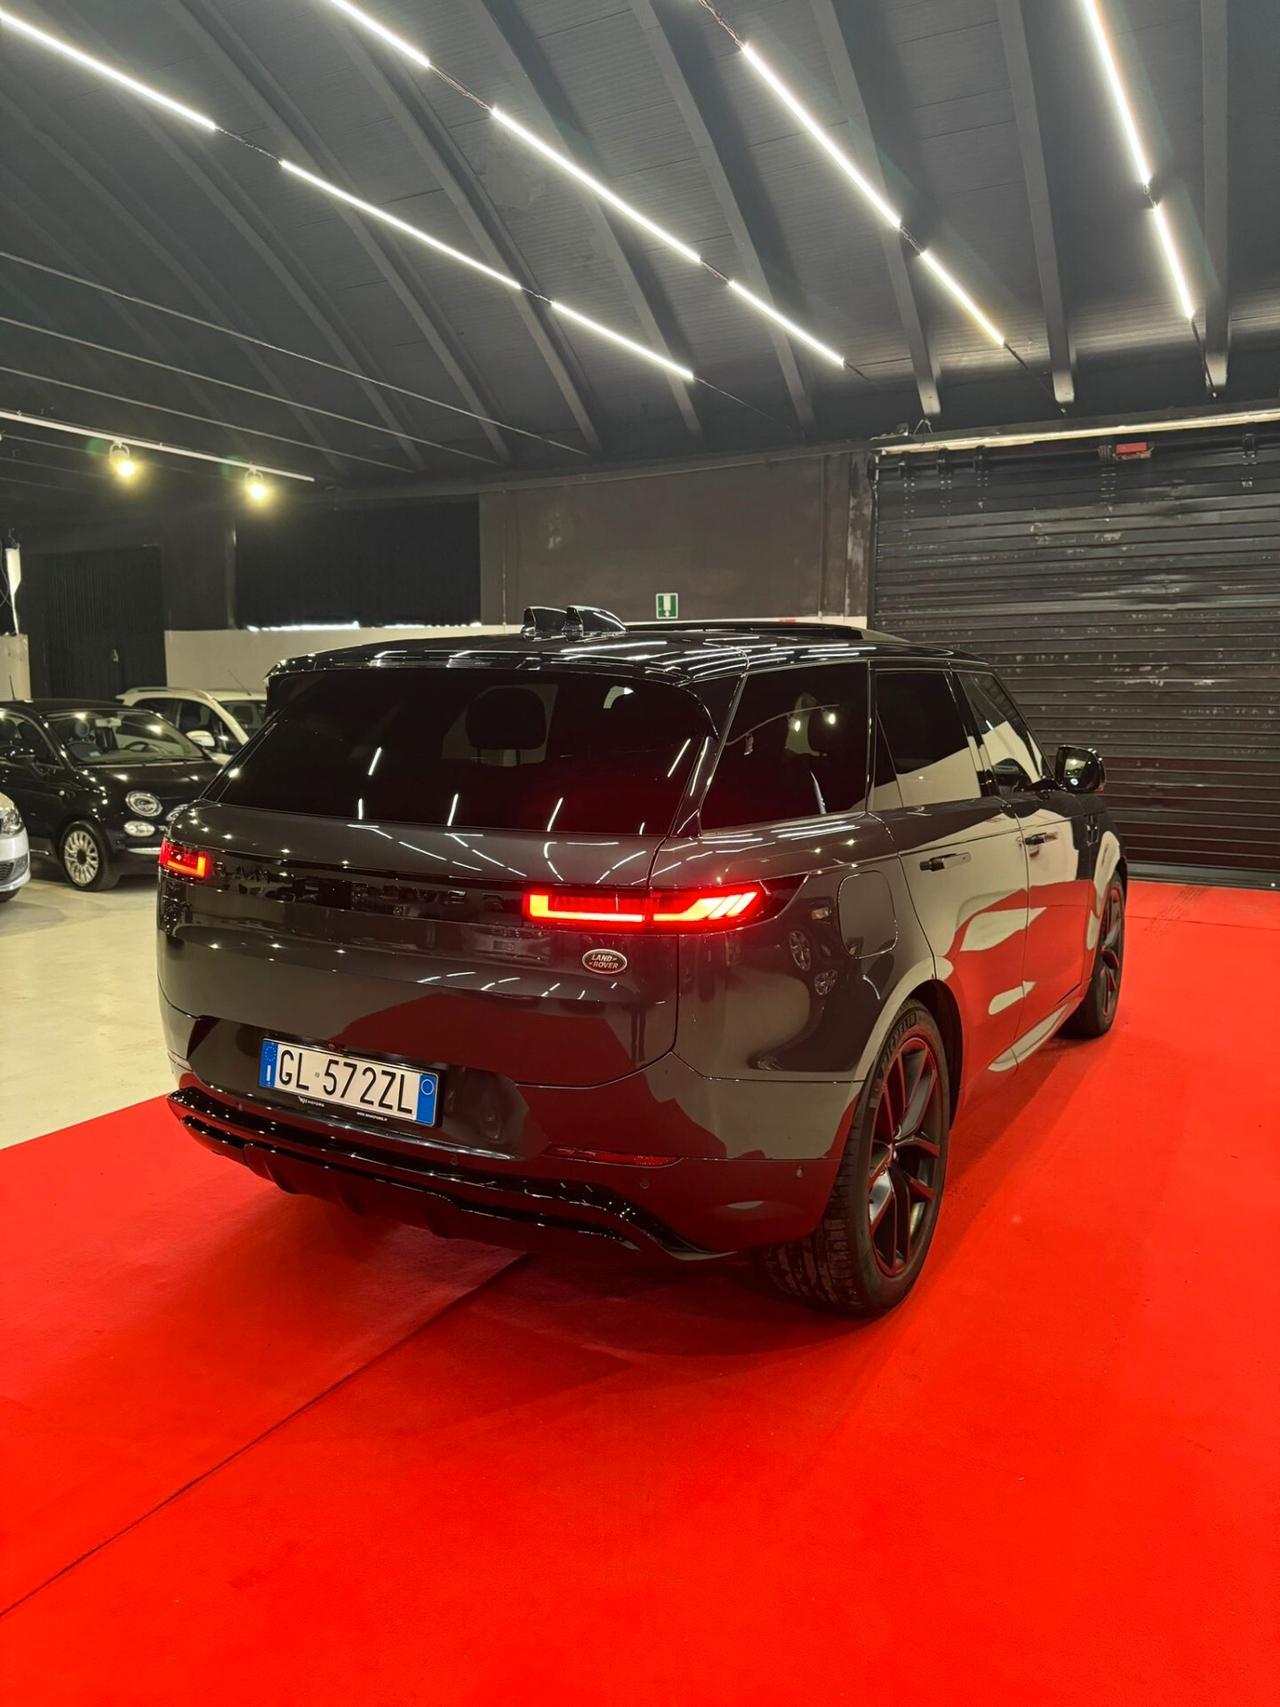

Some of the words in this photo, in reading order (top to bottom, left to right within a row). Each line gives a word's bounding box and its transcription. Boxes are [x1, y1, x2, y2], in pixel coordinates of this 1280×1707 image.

[591, 954, 612, 962] LAND
[593, 961, 618, 969] ROVER
[279, 1050, 310, 1091] GL
[323, 1059, 413, 1114] 572ZL
